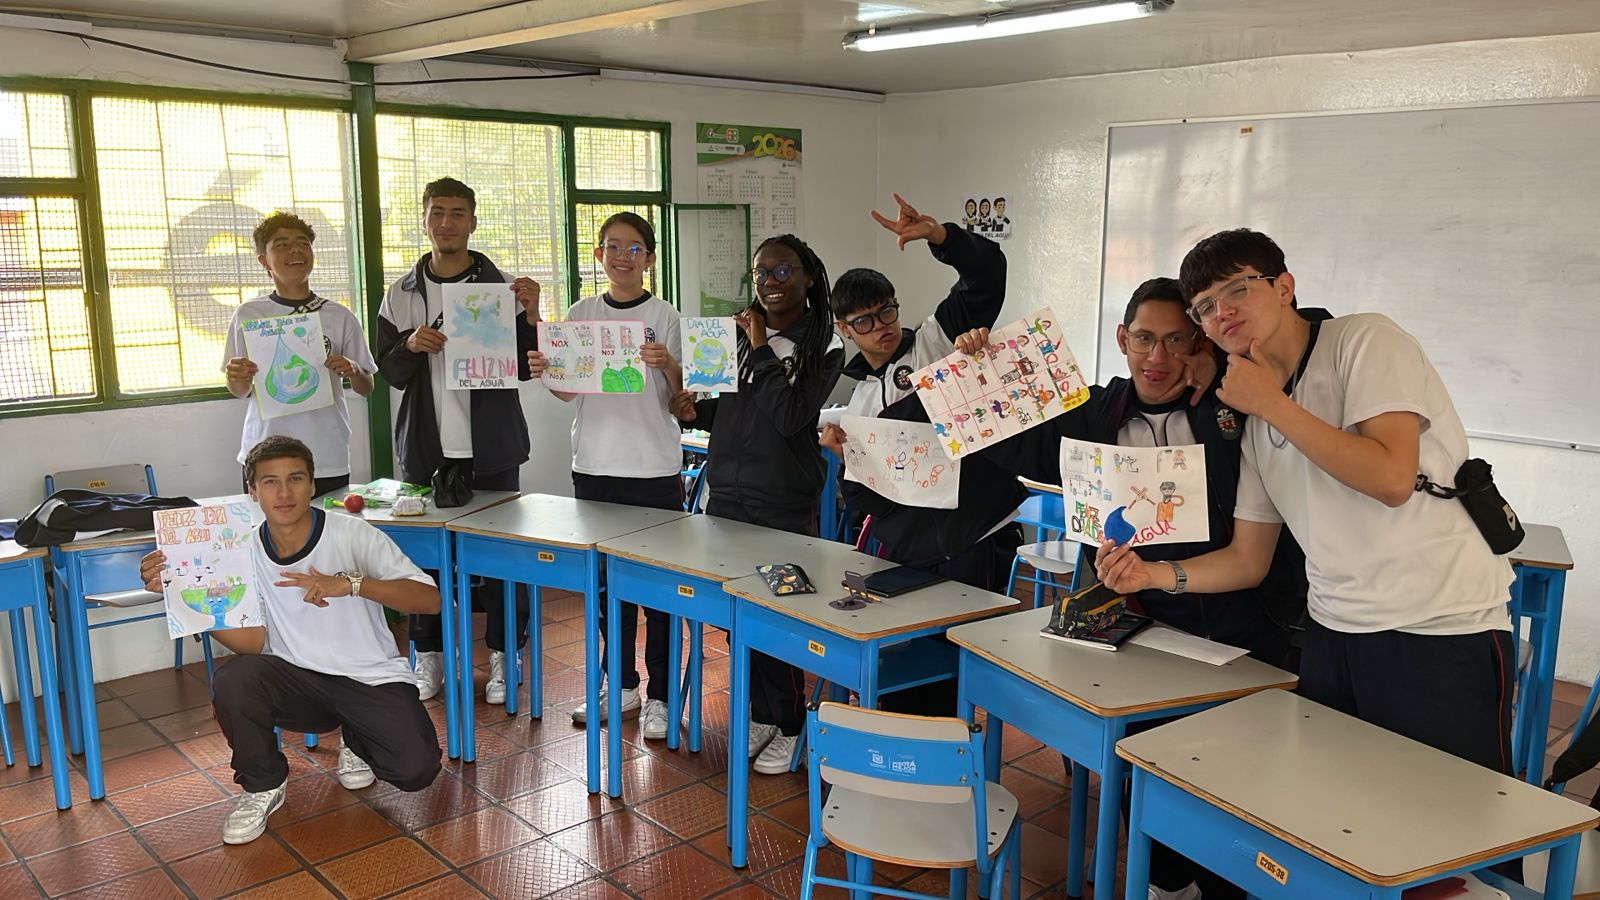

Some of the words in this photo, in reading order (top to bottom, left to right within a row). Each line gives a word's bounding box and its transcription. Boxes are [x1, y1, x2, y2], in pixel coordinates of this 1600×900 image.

[752, 133, 796, 161] 2026
[452, 356, 496, 380] FELIZ
[460, 380, 477, 388] DEL
[479, 379, 505, 388] AGUA
[157, 528, 181, 546] DEL
[1131, 518, 1177, 546] AGUA
[1260, 856, 1284, 880] C205-38
